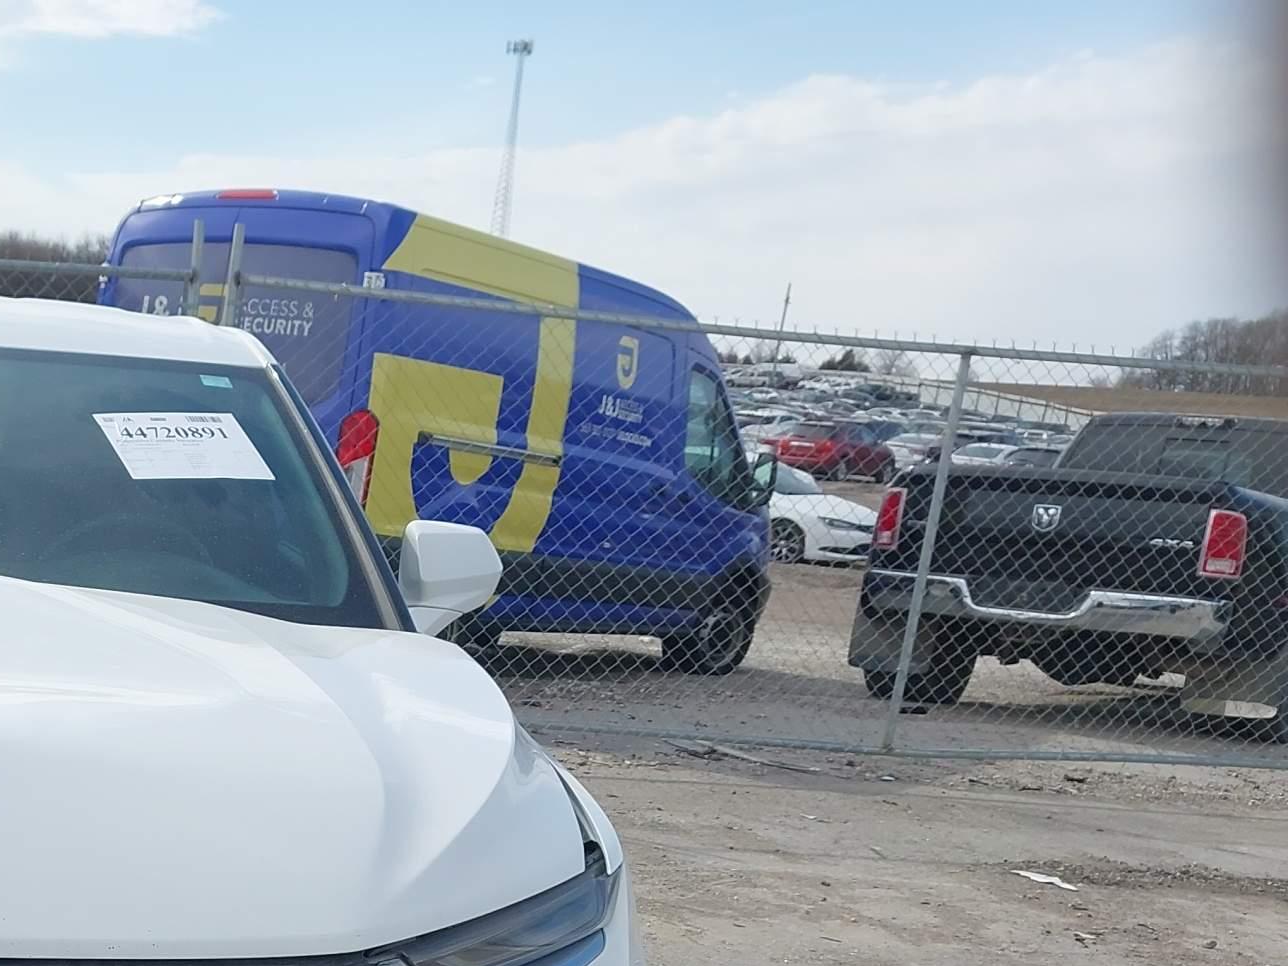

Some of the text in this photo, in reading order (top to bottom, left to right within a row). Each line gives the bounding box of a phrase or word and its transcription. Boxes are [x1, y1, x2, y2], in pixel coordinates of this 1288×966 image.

[243, 298, 299, 317] CCESS
[303, 302, 314, 319] &
[120, 426, 229, 440] 44720891
